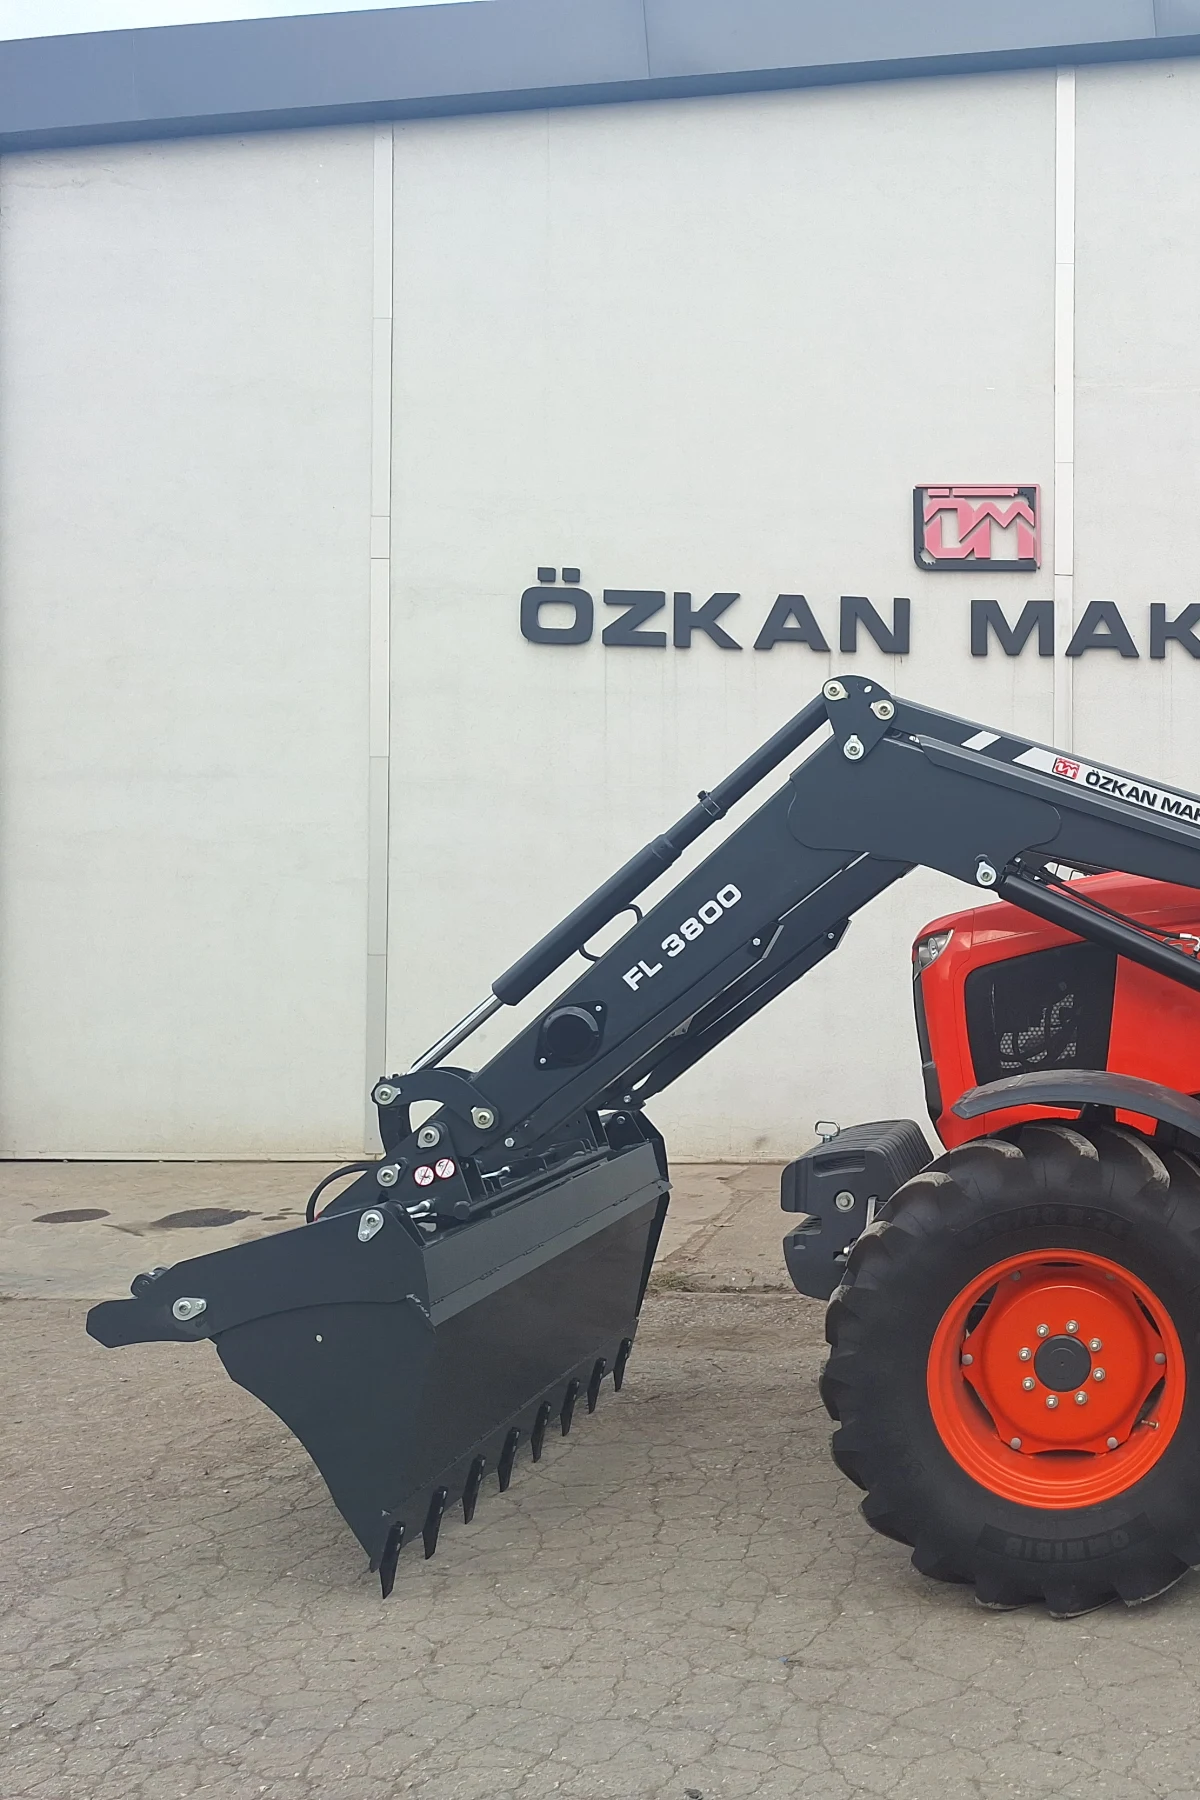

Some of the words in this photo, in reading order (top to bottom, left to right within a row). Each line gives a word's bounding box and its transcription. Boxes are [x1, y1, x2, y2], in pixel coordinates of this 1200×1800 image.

[519, 566, 911, 655] ÖZKAN
[1085, 769, 1158, 807] ÖZKAN
[622, 960, 663, 991] FL
[661, 883, 742, 957] 3800
